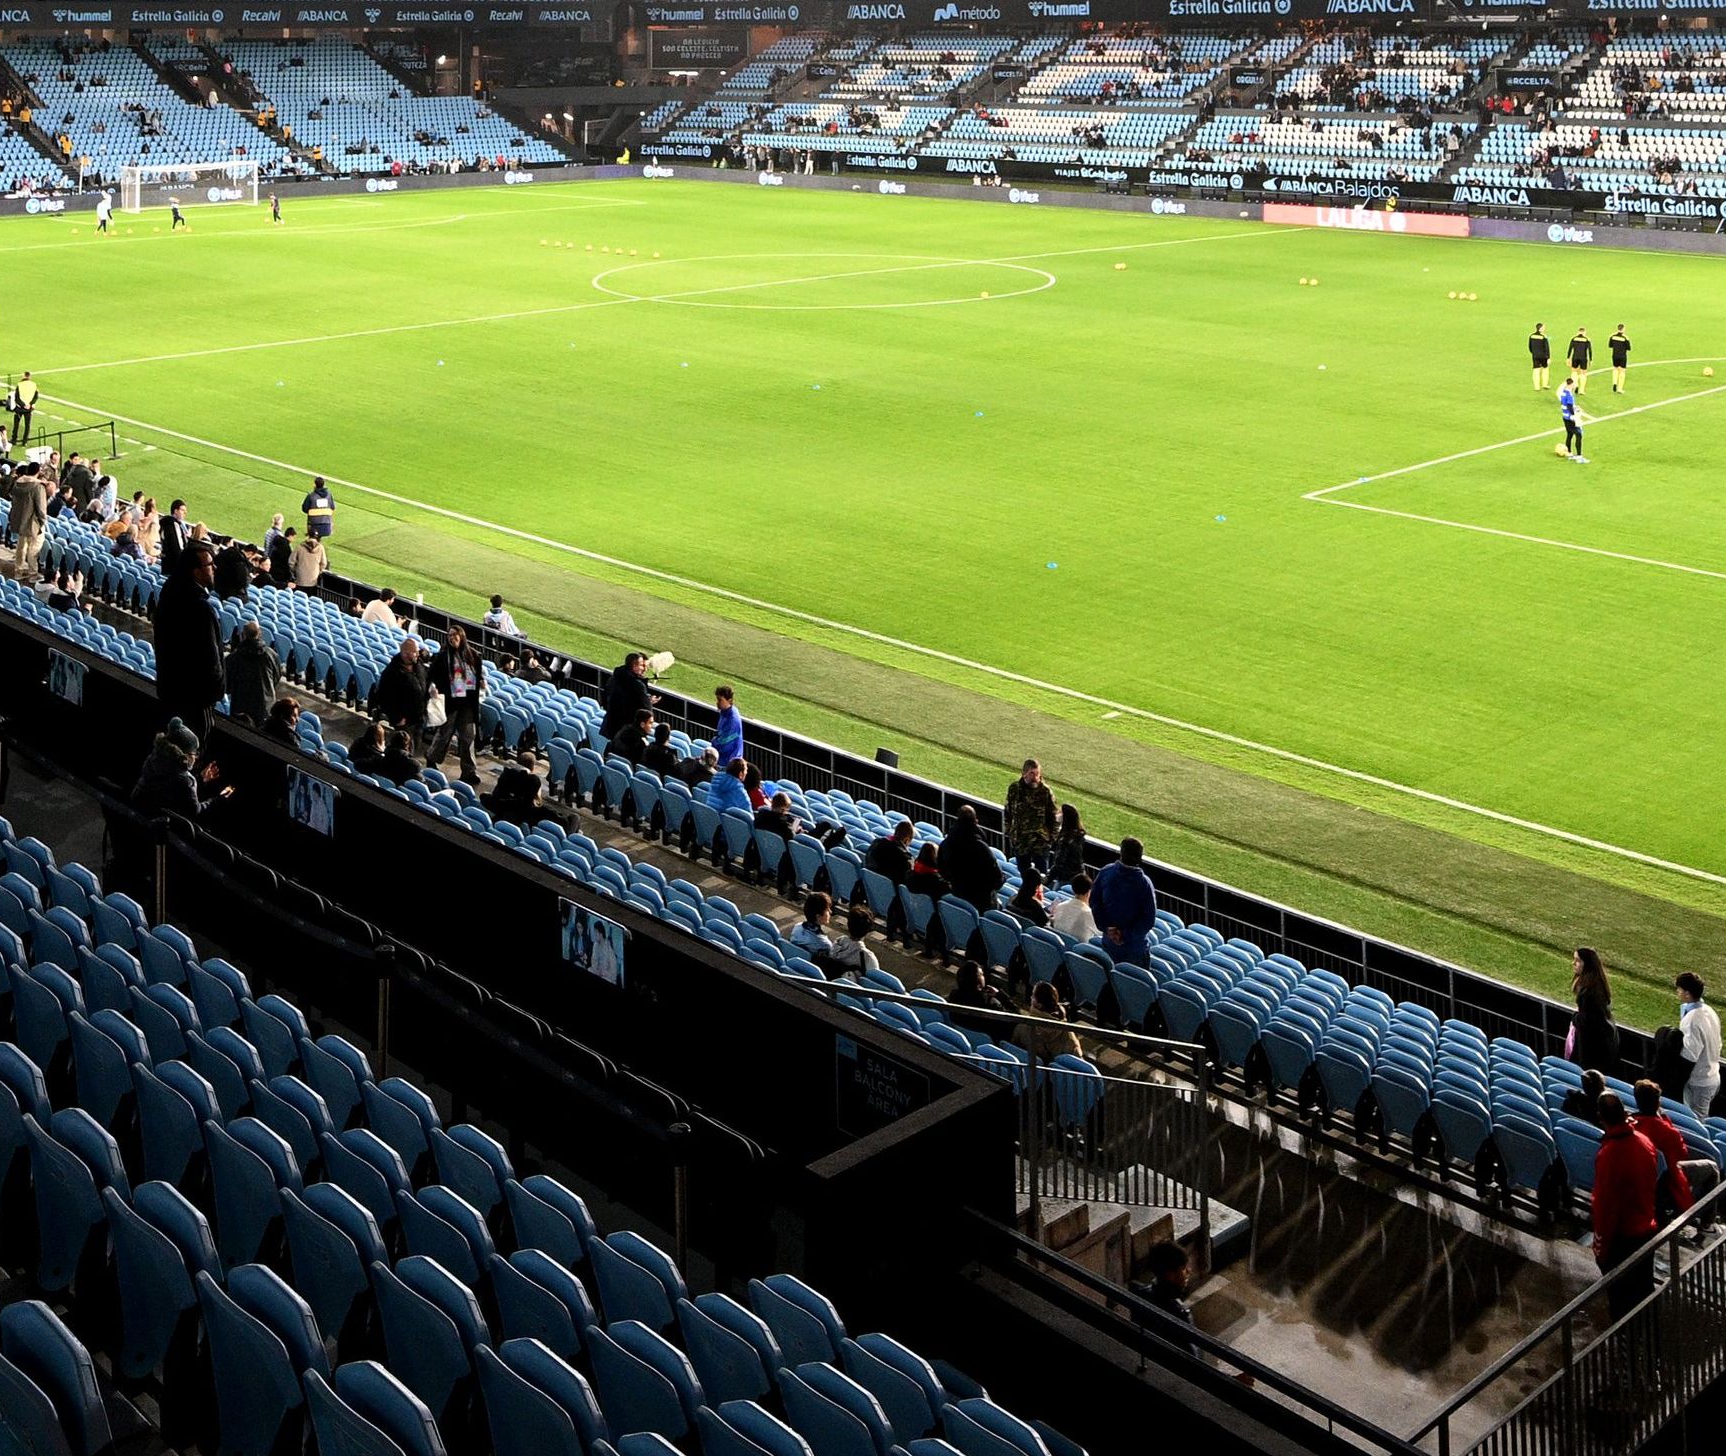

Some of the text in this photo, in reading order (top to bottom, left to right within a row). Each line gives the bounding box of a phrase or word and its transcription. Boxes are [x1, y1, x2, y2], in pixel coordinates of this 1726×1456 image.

[67, 9, 112, 22] hummel
[131, 10, 209, 22] Estrella Galicia
[242, 9, 281, 22] Recalvi
[302, 10, 348, 22] ABANCA
[396, 10, 462, 22] Estrella Galicia
[489, 10, 523, 21] Recalvi
[543, 10, 591, 22] ABANCA
[661, 8, 704, 20] hummel
[714, 7, 786, 20] Estrella Galicia
[852, 4, 906, 19] ABANCA
[959, 4, 1001, 20] método
[1043, 1, 1090, 16] hummel
[641, 144, 703, 156] Estrella Galicia
[846, 154, 906, 169] Estrella Galicia
[951, 159, 997, 174] ABANCA
[1149, 171, 1227, 188] Estrella Galicia
[1459, 187, 1531, 206] ABANCA
[1604, 195, 1716, 218] Estrella Galicia
[1316, 206, 1384, 230] LALIGA
[866, 1057, 897, 1081] SALA
[855, 1070, 911, 1106] BALCONY
